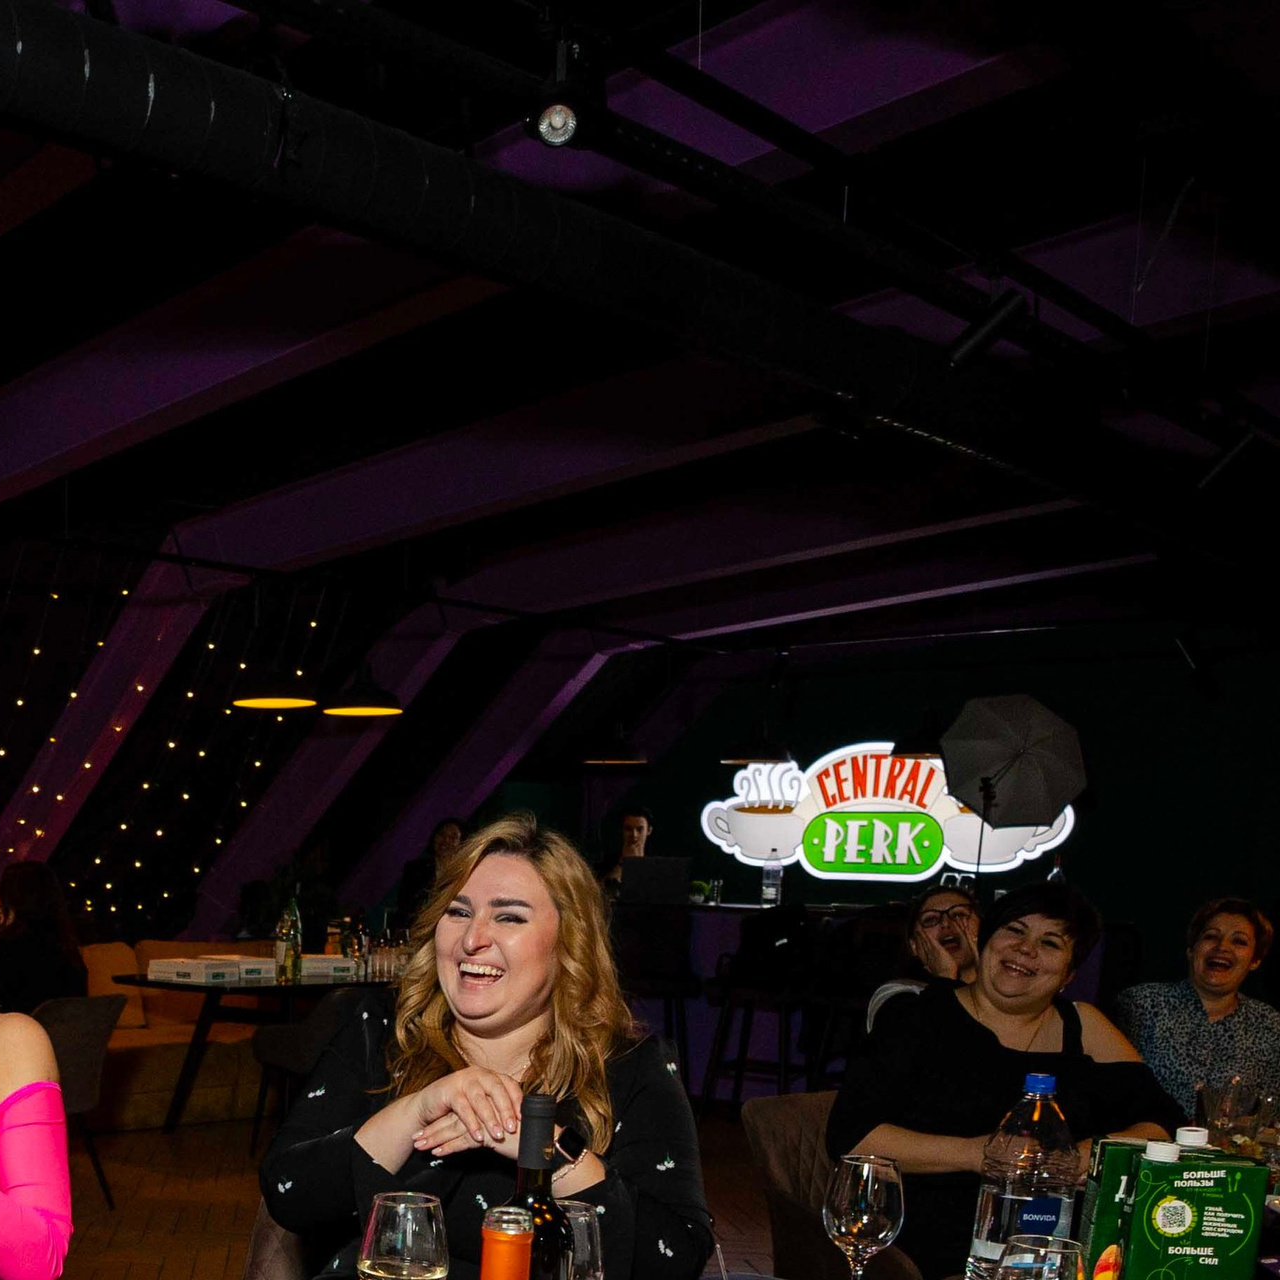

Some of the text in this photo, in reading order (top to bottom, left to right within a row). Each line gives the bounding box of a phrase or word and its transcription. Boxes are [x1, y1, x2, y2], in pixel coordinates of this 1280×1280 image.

[817, 754, 935, 809] CENTRAL
[823, 818, 926, 864] PERK
[1183, 1171, 1226, 1179] БОЛЬШЕ
[1023, 1214, 1057, 1223] BONVIDA
[1168, 1246, 1214, 1255] БОЛЬШЕ
[1199, 1257, 1218, 1265] СИЛ
